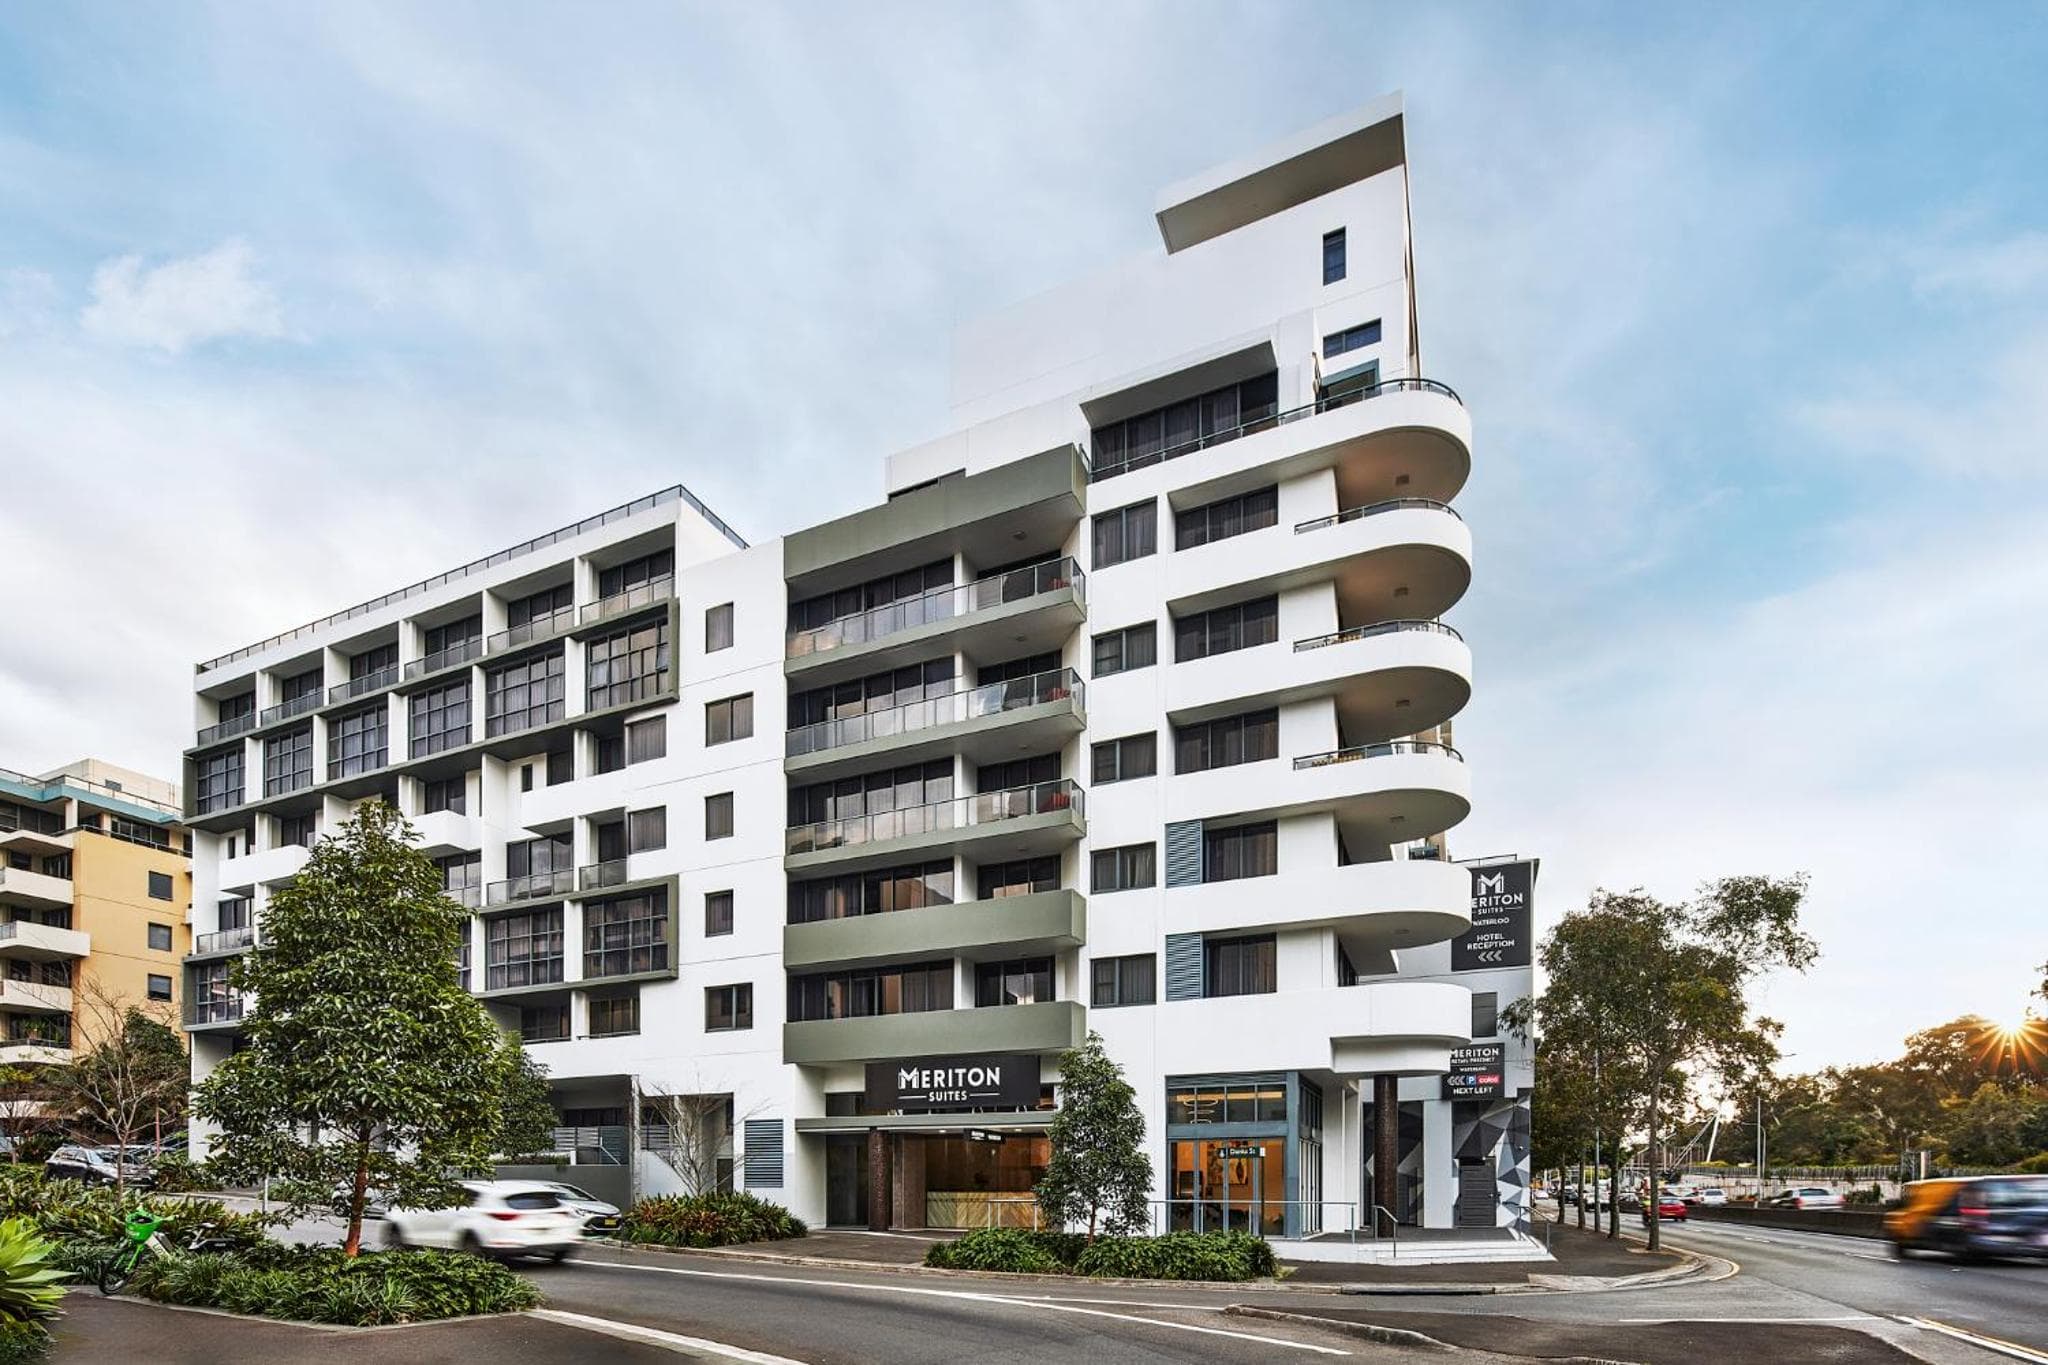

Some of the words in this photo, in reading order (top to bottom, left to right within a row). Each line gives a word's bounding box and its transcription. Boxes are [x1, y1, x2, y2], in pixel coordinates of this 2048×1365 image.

[1471, 893, 1523, 908] ERITON
[1478, 907, 1503, 915] SUITES
[1476, 933, 1504, 942] HOTEL
[1467, 939, 1515, 951] RECEPTION
[898, 1067, 1000, 1089] MERITON
[1453, 1087, 1473, 1095] NEXT
[1474, 1086, 1493, 1094] LEFT
[929, 1091, 967, 1102] SUITES
